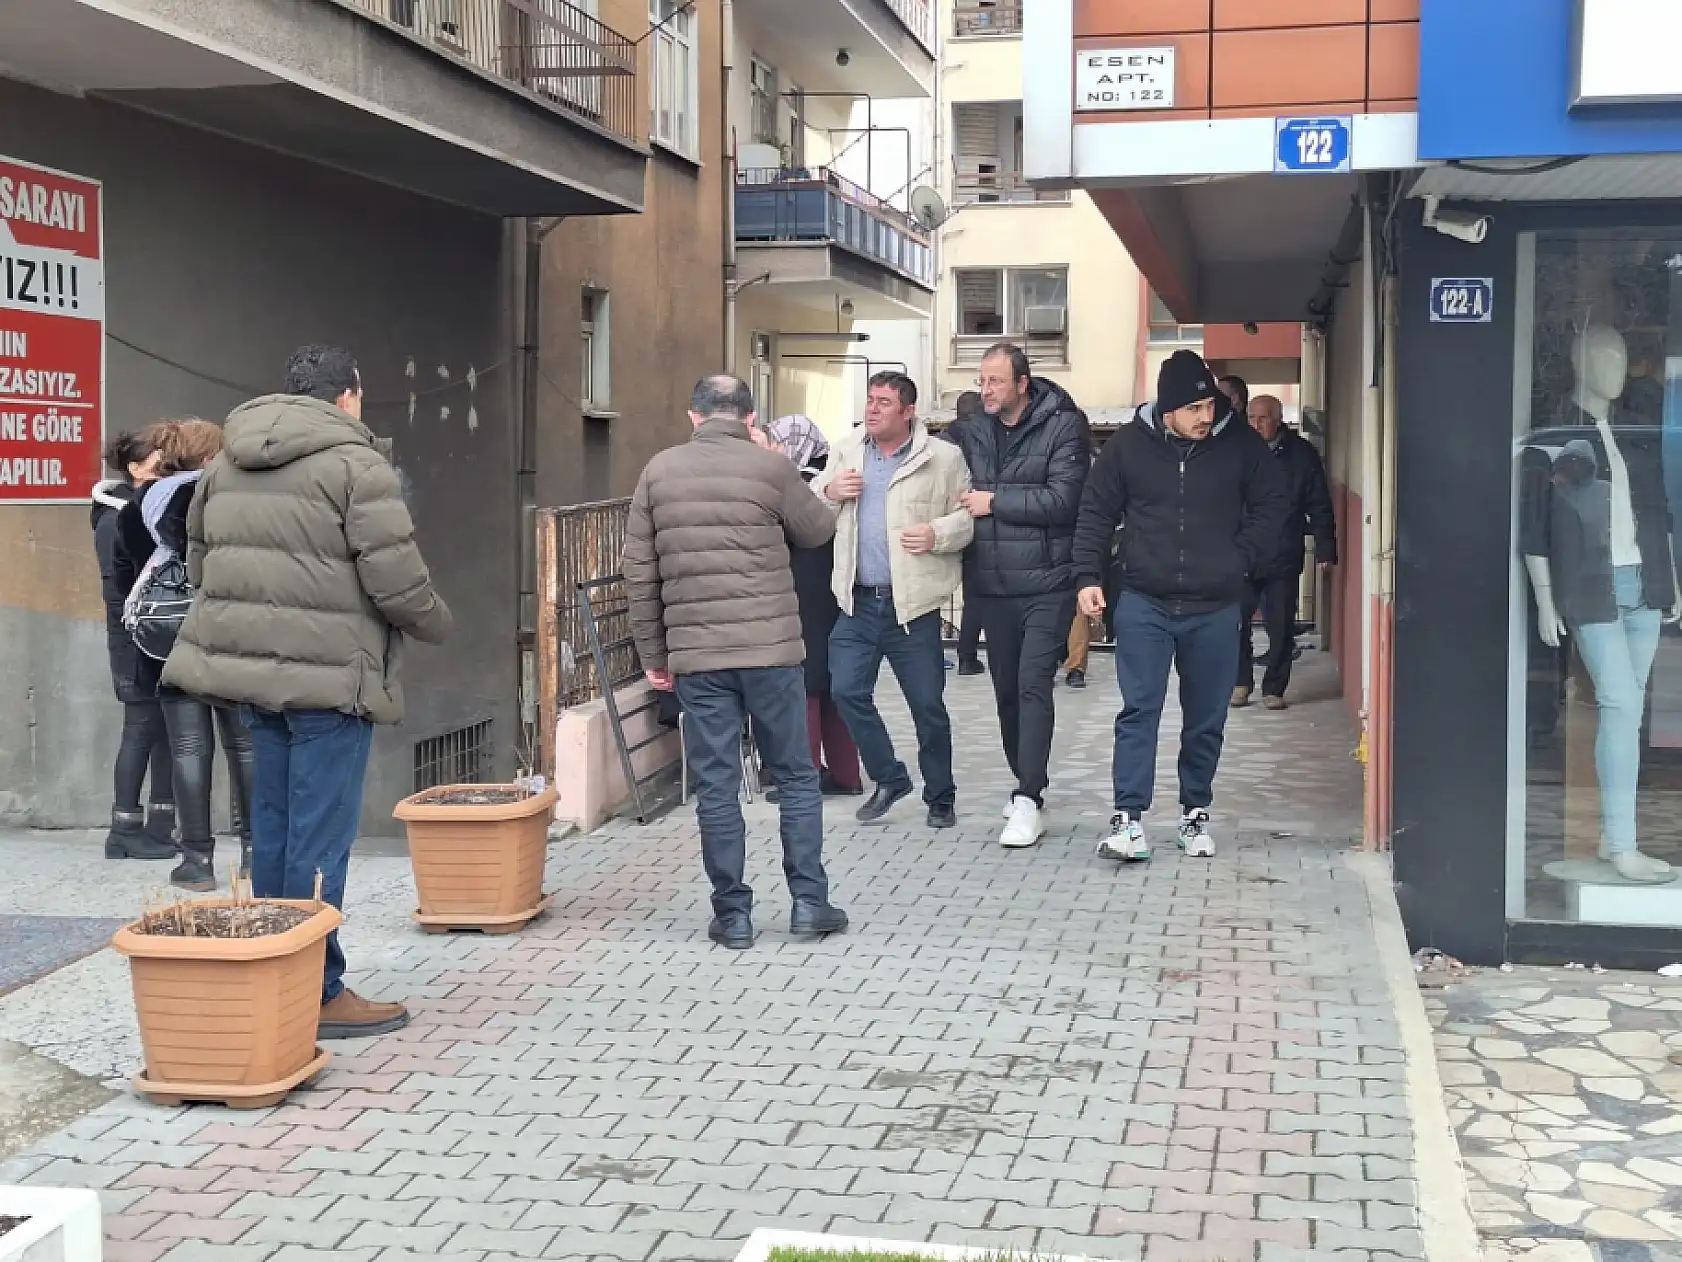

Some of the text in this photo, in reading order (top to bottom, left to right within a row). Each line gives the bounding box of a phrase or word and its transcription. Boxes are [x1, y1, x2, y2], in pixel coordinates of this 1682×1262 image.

[1088, 55, 1164, 68] ESEN
[1097, 73, 1154, 84] APT.
[1088, 90, 1163, 102] NO: 122
[1297, 129, 1332, 164] 122
[0, 176, 86, 233] SARAYI
[0, 255, 78, 309] IZ!!!
[1441, 288, 1482, 315] 122-A
[33, 408, 82, 442] GÖRE
[0, 457, 67, 485] APILIR.
